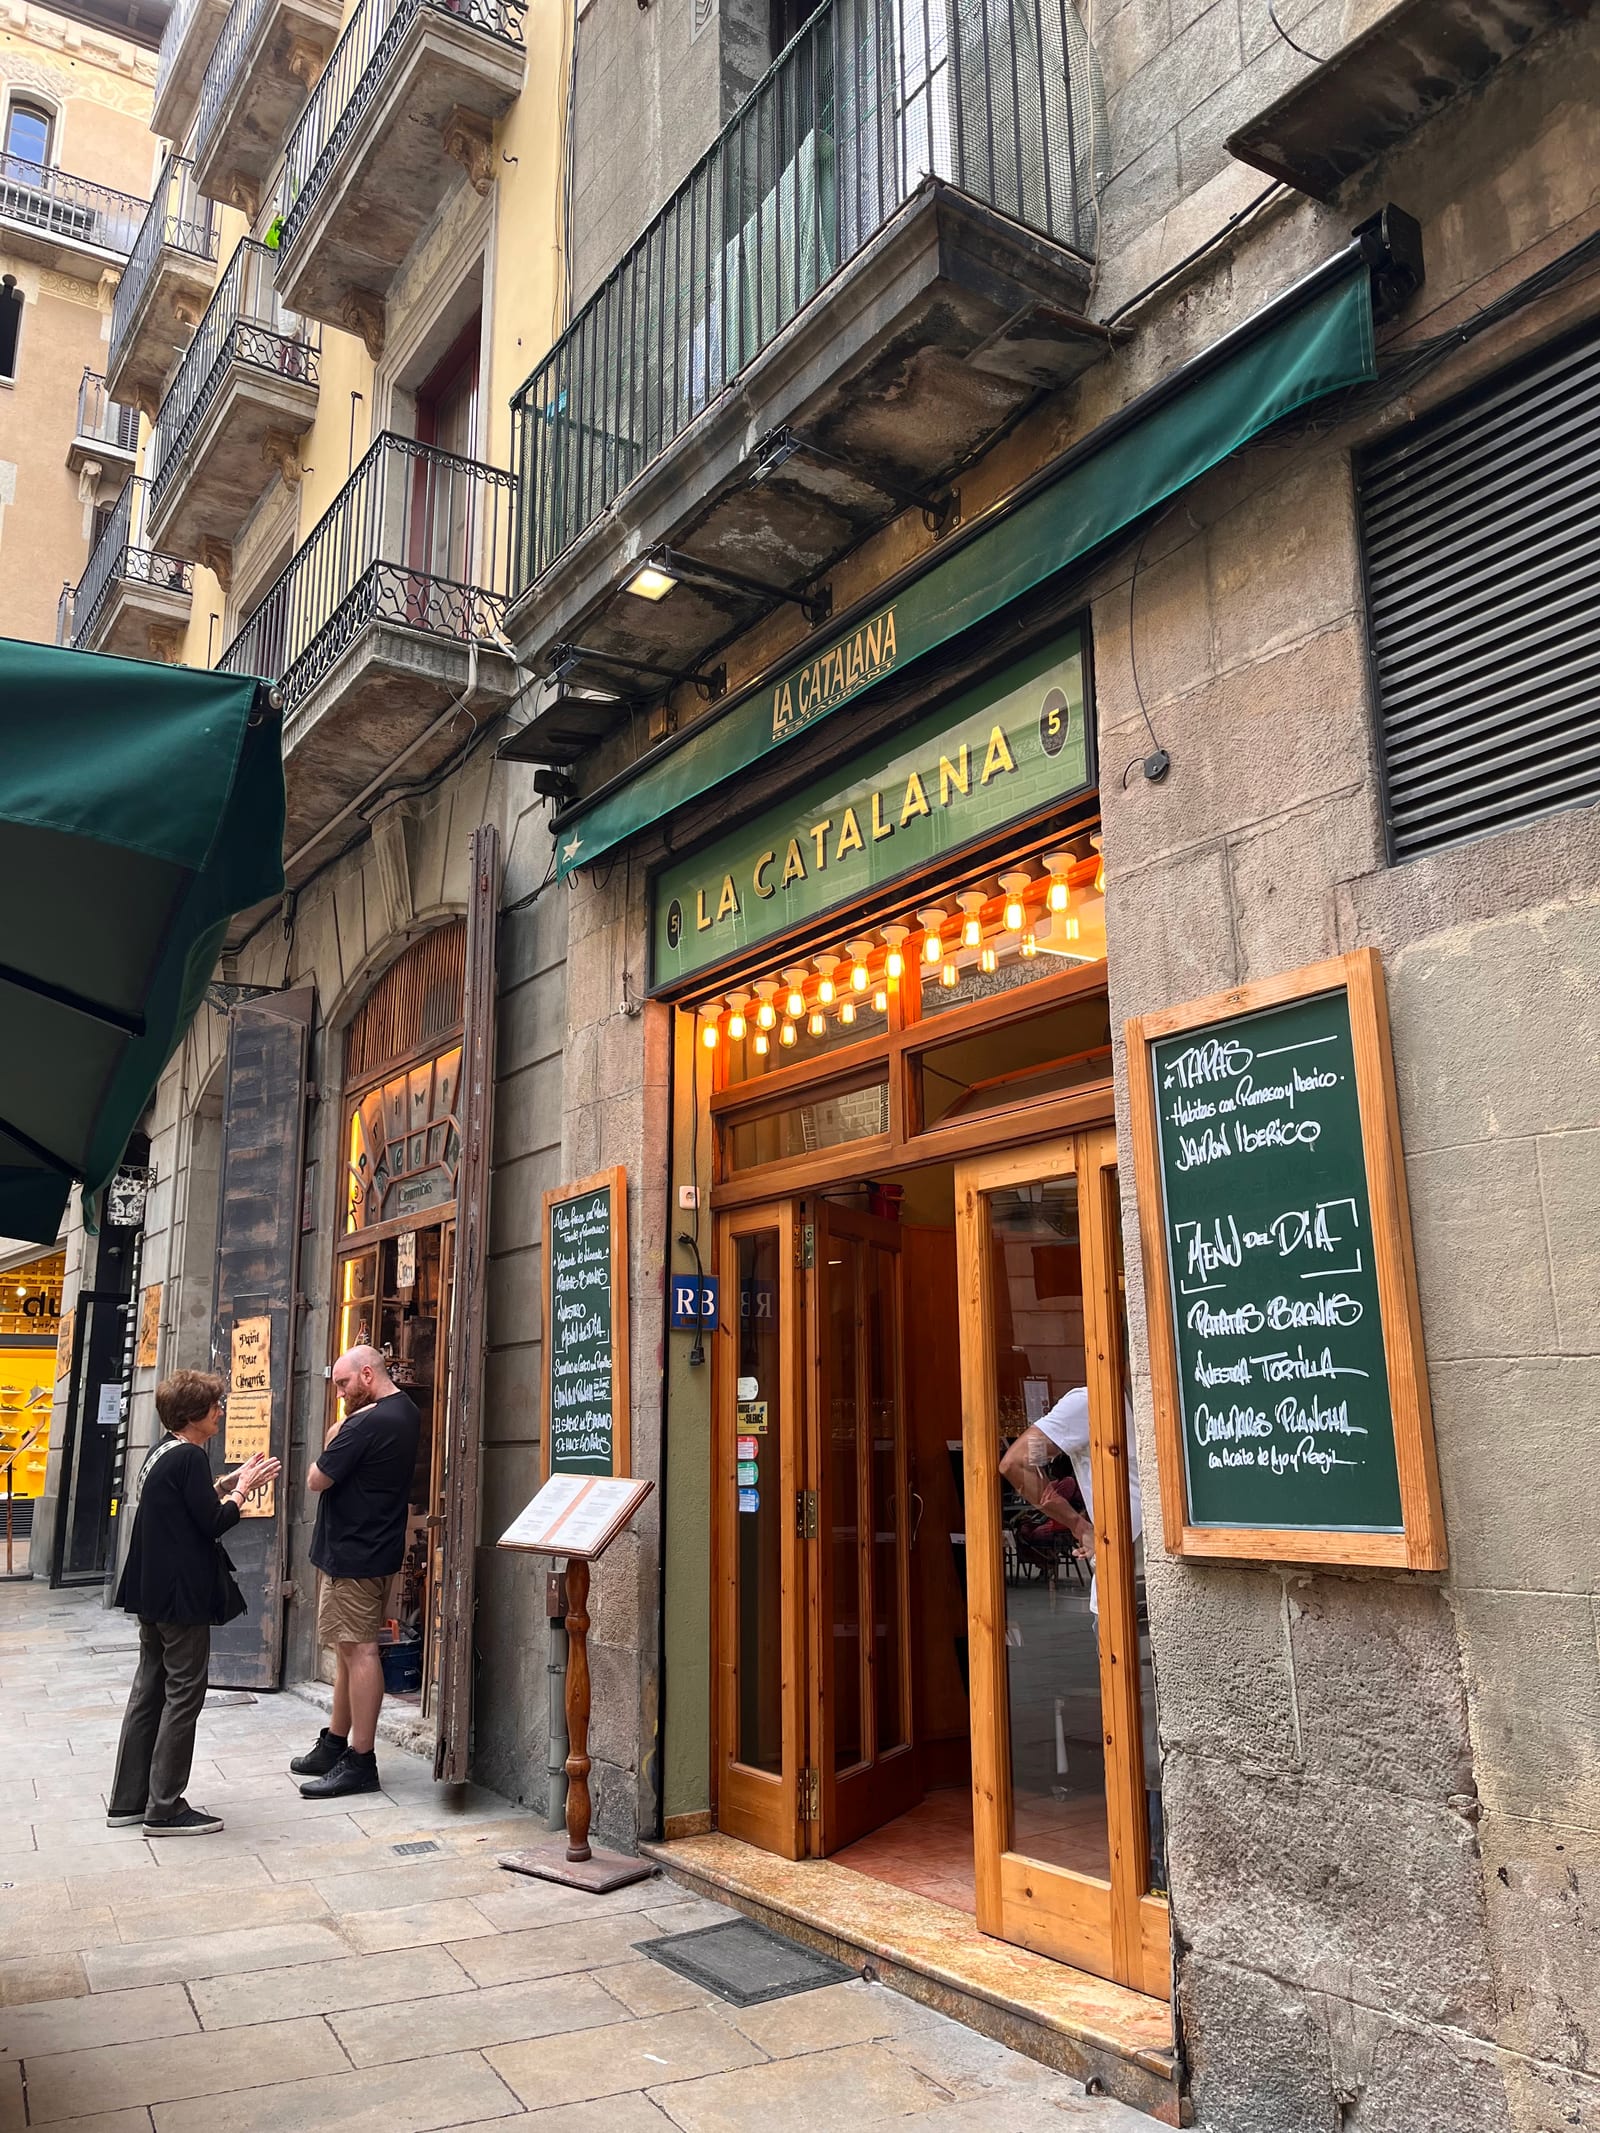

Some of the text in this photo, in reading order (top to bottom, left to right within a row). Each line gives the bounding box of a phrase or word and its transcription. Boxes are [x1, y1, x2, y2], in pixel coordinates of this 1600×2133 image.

[772, 611, 897, 732] LA CATALANA
[1048, 707, 1061, 735] 5
[696, 725, 1019, 933] LA CATALANA
[670, 914, 679, 933] 5
[1165, 1039, 1253, 1089] TAPAS
[1171, 1067, 1337, 1127] Habitas con Romesco y Iberico
[1175, 1122, 1231, 1171] JAMON
[1188, 1215, 1242, 1283] MENU
[1188, 1292, 1363, 1338] PATATAS BRAVAS
[1195, 1350, 1252, 1388] NUESTRA
[1194, 1394, 1368, 1446] CALAMARES PLANCHA
[1223, 1448, 1254, 1466] Aceite
[1258, 1446, 1269, 1466] de
[1271, 1445, 1290, 1475] Ajo
[1289, 1453, 1299, 1473] y
